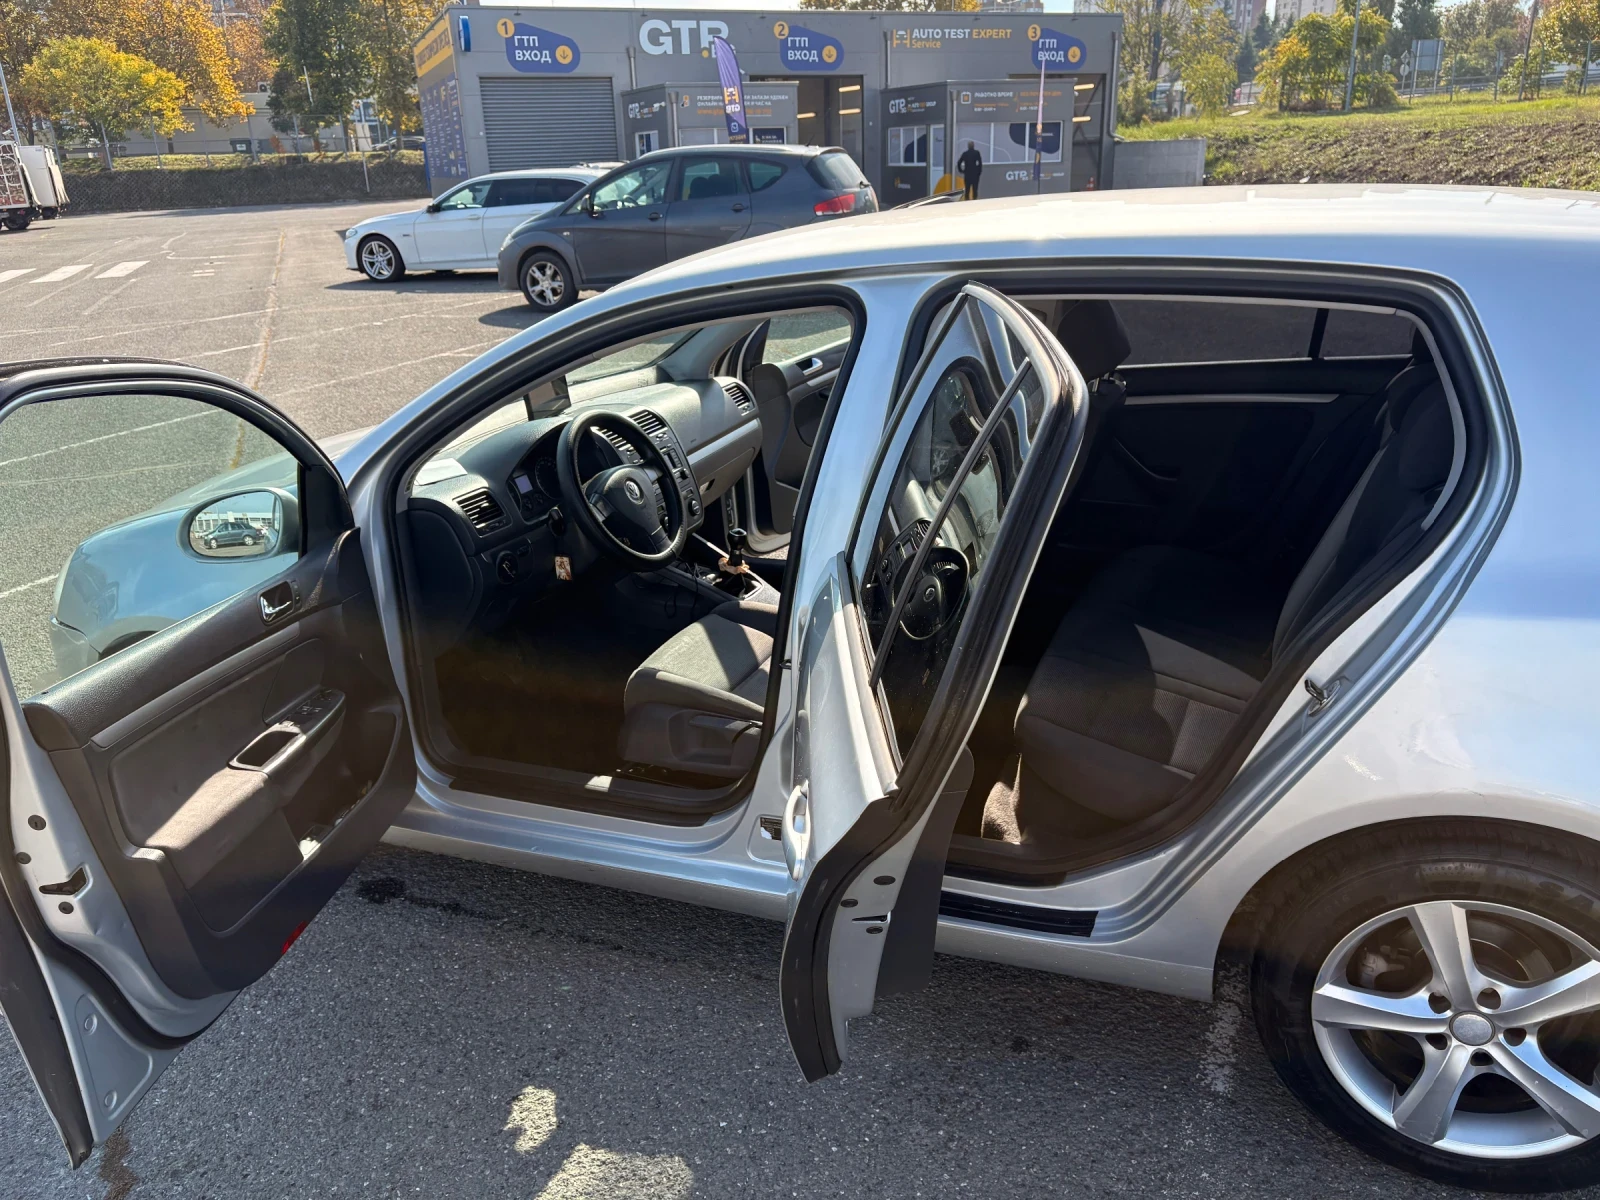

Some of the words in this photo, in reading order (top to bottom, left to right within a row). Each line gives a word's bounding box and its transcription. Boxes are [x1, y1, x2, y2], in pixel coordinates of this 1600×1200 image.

[501, 21, 509, 35] 1
[778, 23, 786, 37] 2
[912, 29, 942, 39] AUTO
[944, 29, 970, 39] TEST
[972, 29, 1012, 39] EXPERT
[1030, 26, 1038, 39] 3
[514, 35, 539, 47] ГТП
[787, 37, 809, 48] ГТП
[912, 39, 942, 48] Service
[1039, 38, 1057, 49] ГТП
[515, 50, 552, 64] ВХОД
[787, 50, 819, 63] ВХОД
[1037, 50, 1065, 63] ВХОД
